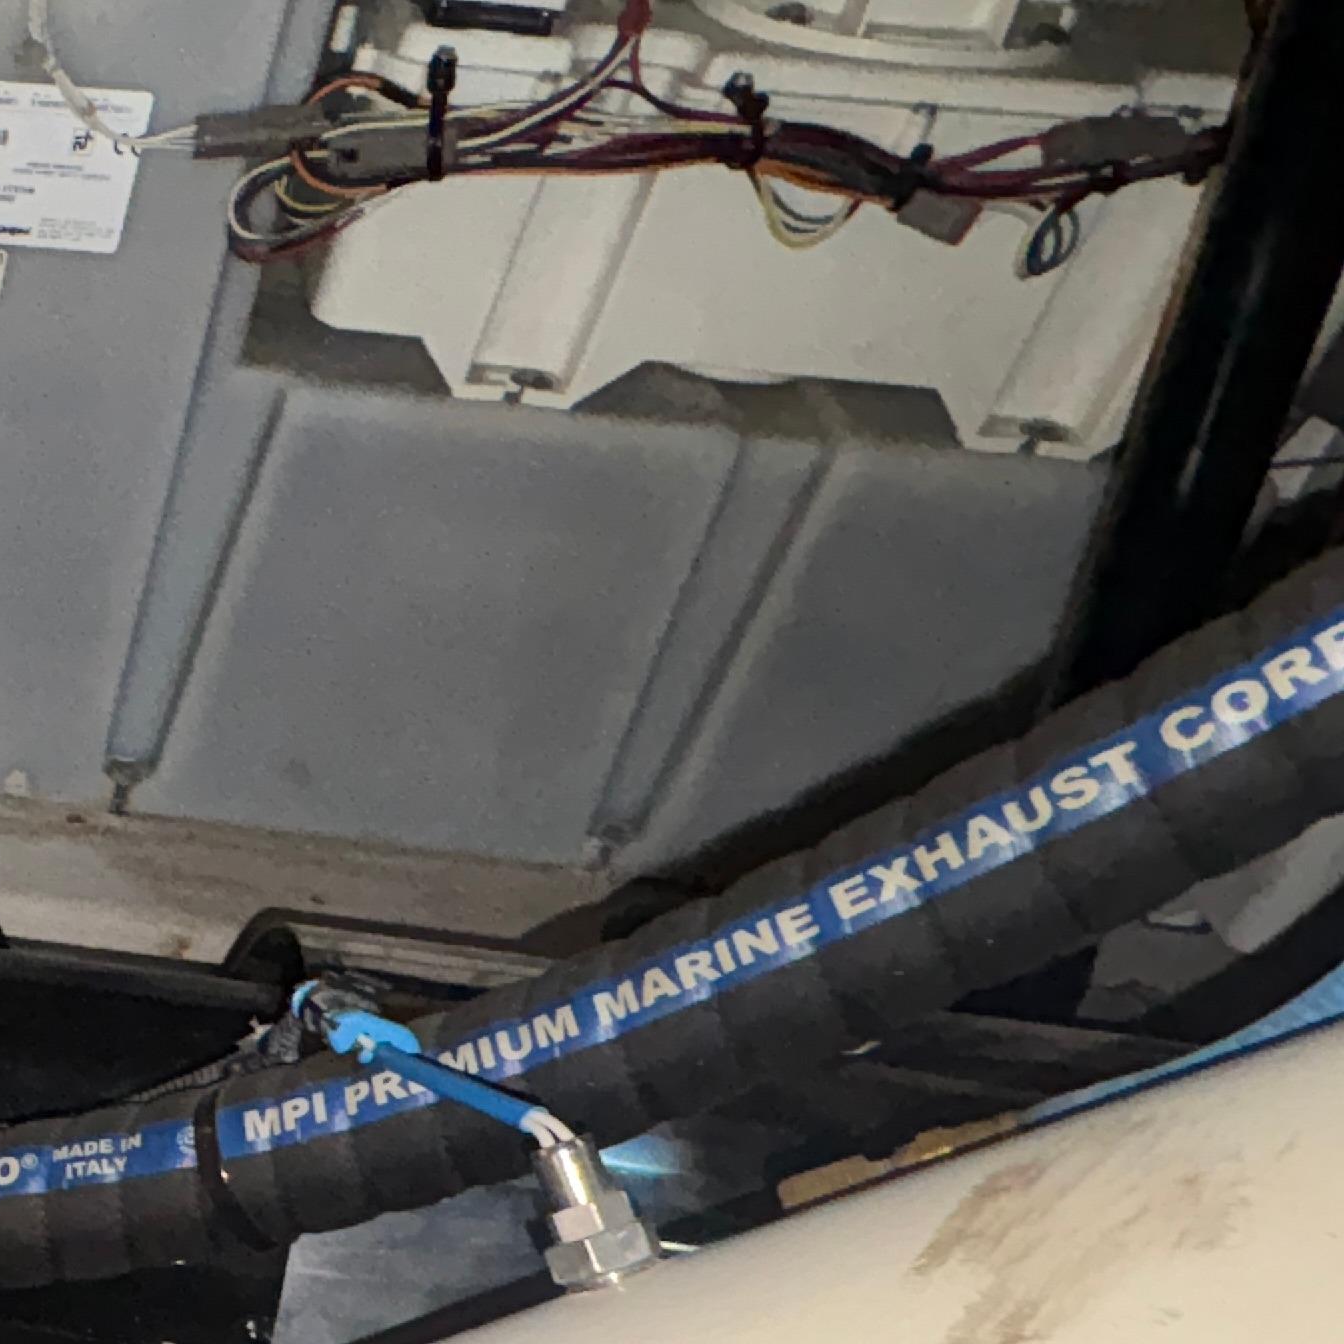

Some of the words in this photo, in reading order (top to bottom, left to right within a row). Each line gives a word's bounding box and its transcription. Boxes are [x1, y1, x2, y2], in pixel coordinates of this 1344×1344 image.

[242, 1089, 329, 1142] MPI
[591, 903, 821, 1024] MARINE
[827, 740, 1139, 921] EXHAUST
[52, 1137, 114, 1163] MADE
[120, 1132, 143, 1154] IN
[64, 1155, 128, 1180] ITALY
